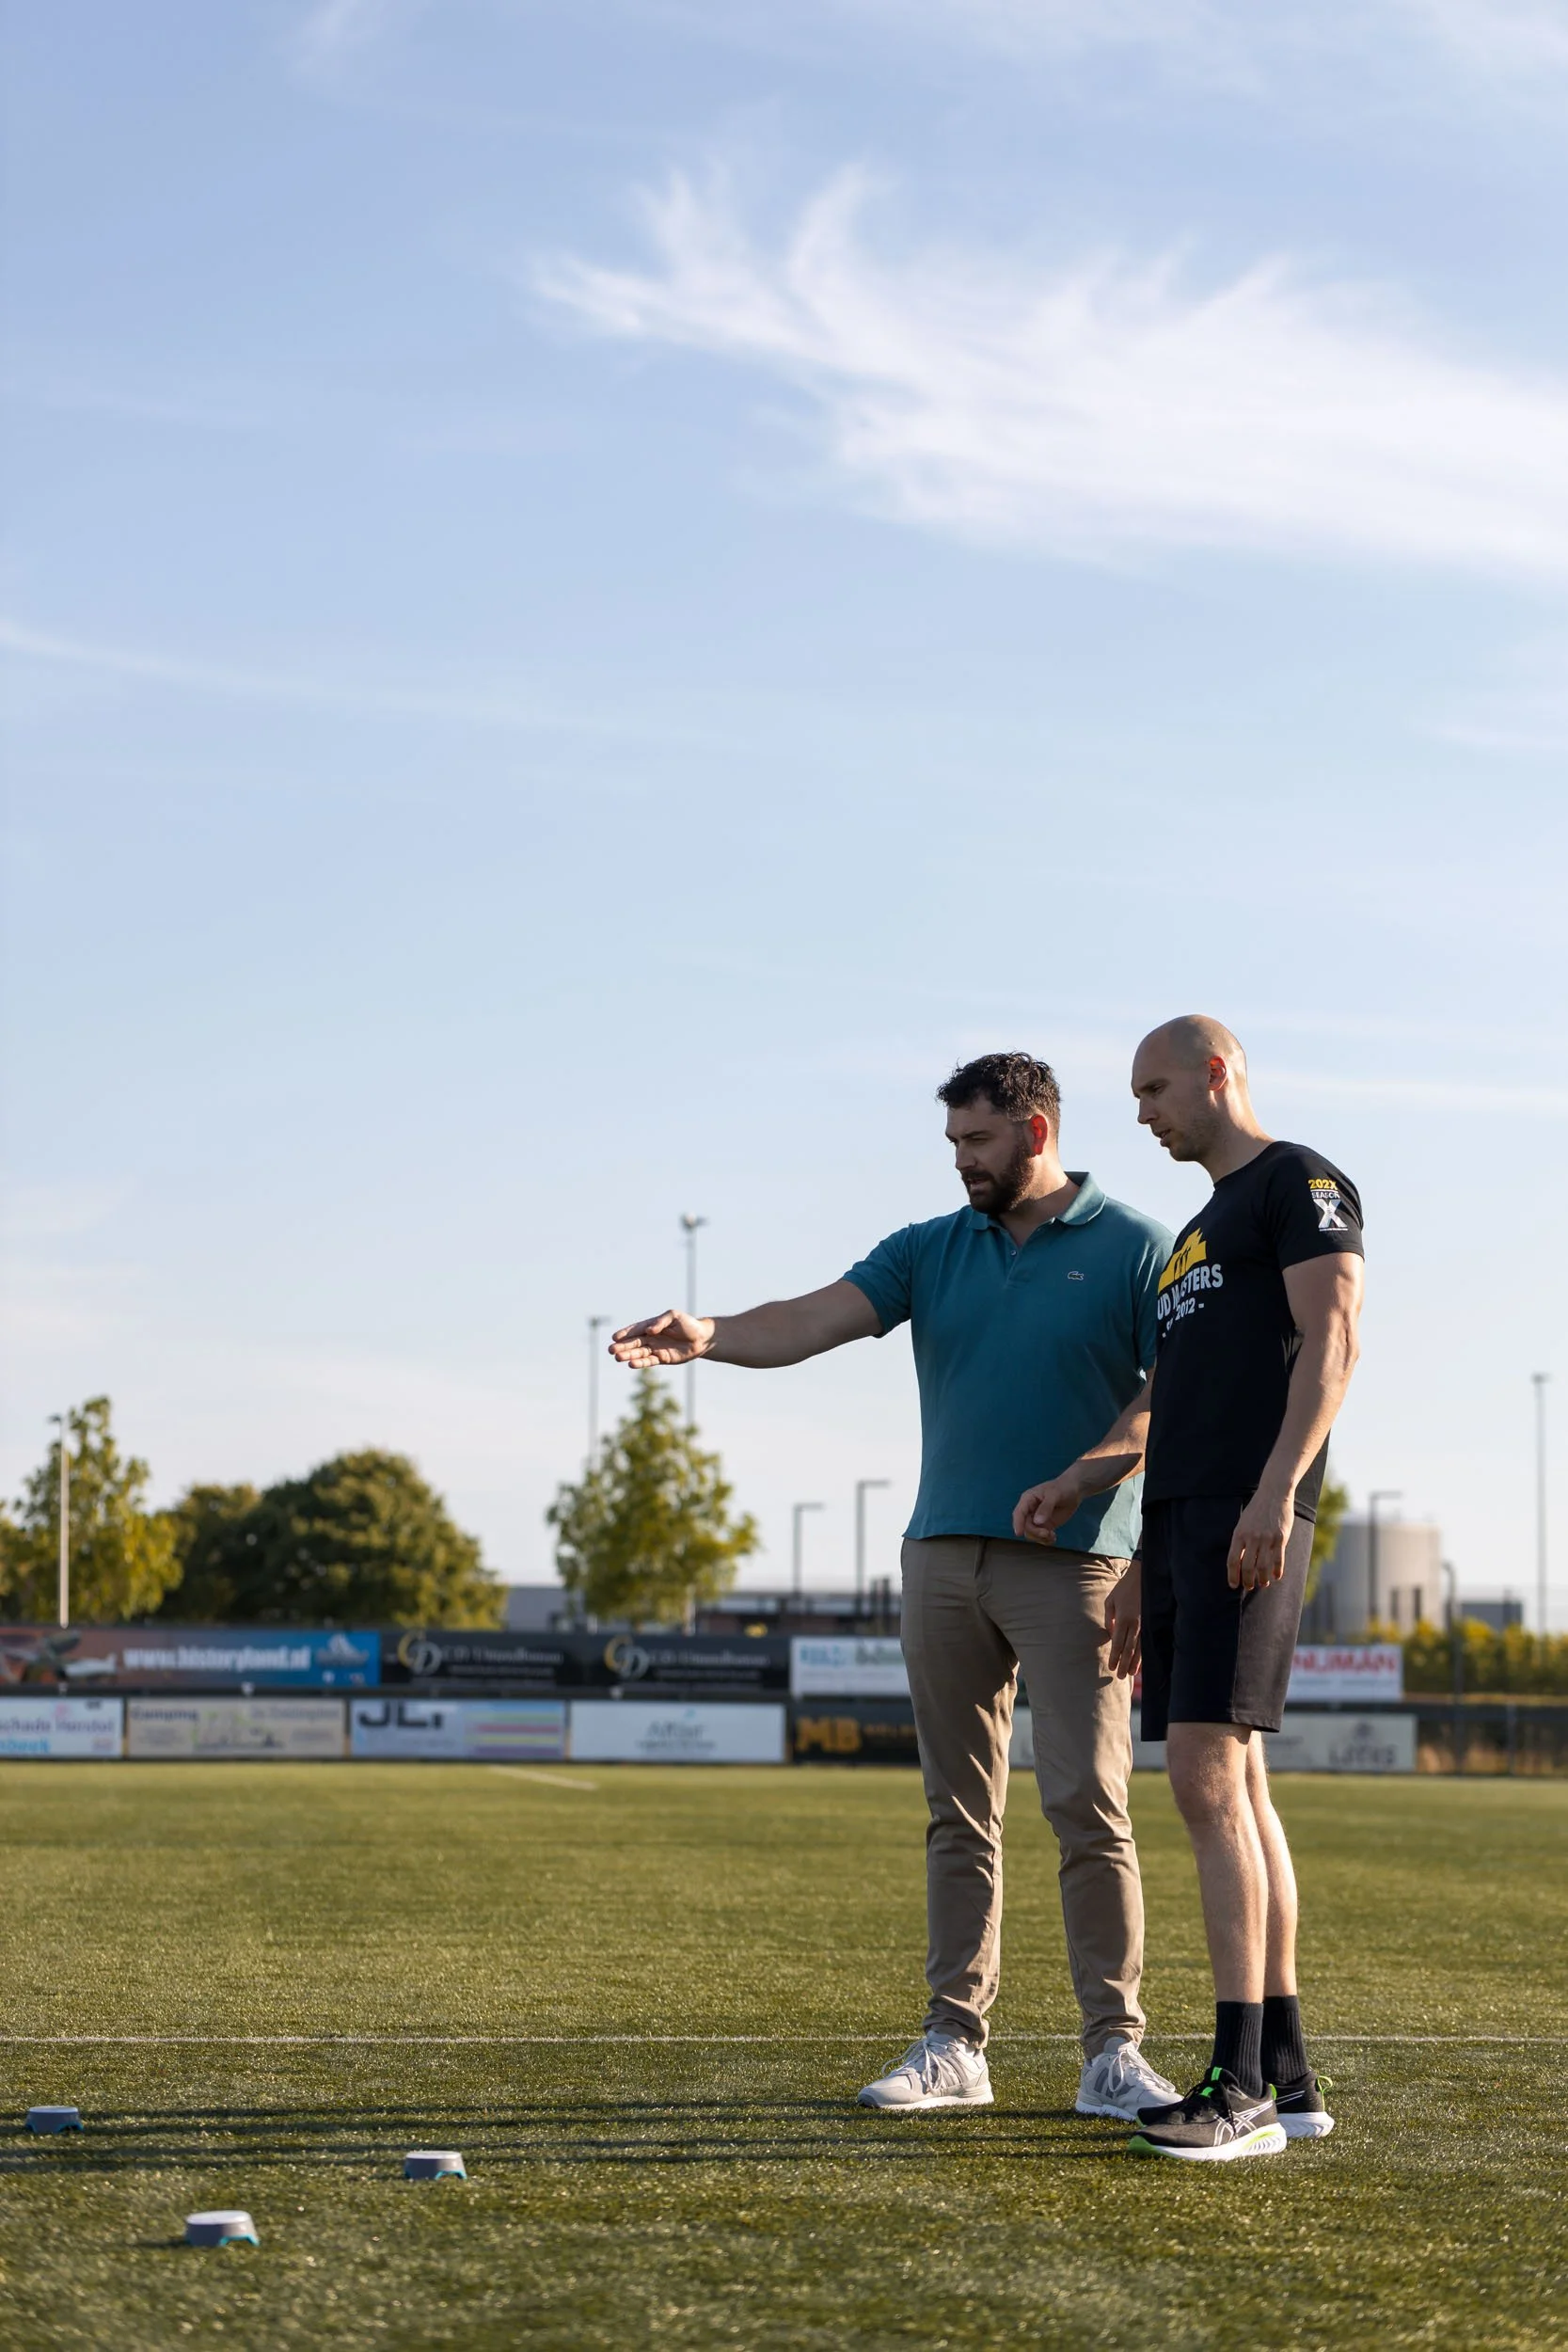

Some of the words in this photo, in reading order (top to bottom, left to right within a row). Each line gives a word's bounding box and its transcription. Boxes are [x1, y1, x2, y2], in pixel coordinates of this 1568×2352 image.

[1308, 1178, 1338, 1191] 202X
[1311, 1191, 1341, 1200] SEASON
[1313, 1199, 1348, 1229] X
[1157, 1293, 1172, 1321] UD
[1175, 1297, 1196, 1321] 2012
[796, 1716, 863, 1752] MB
